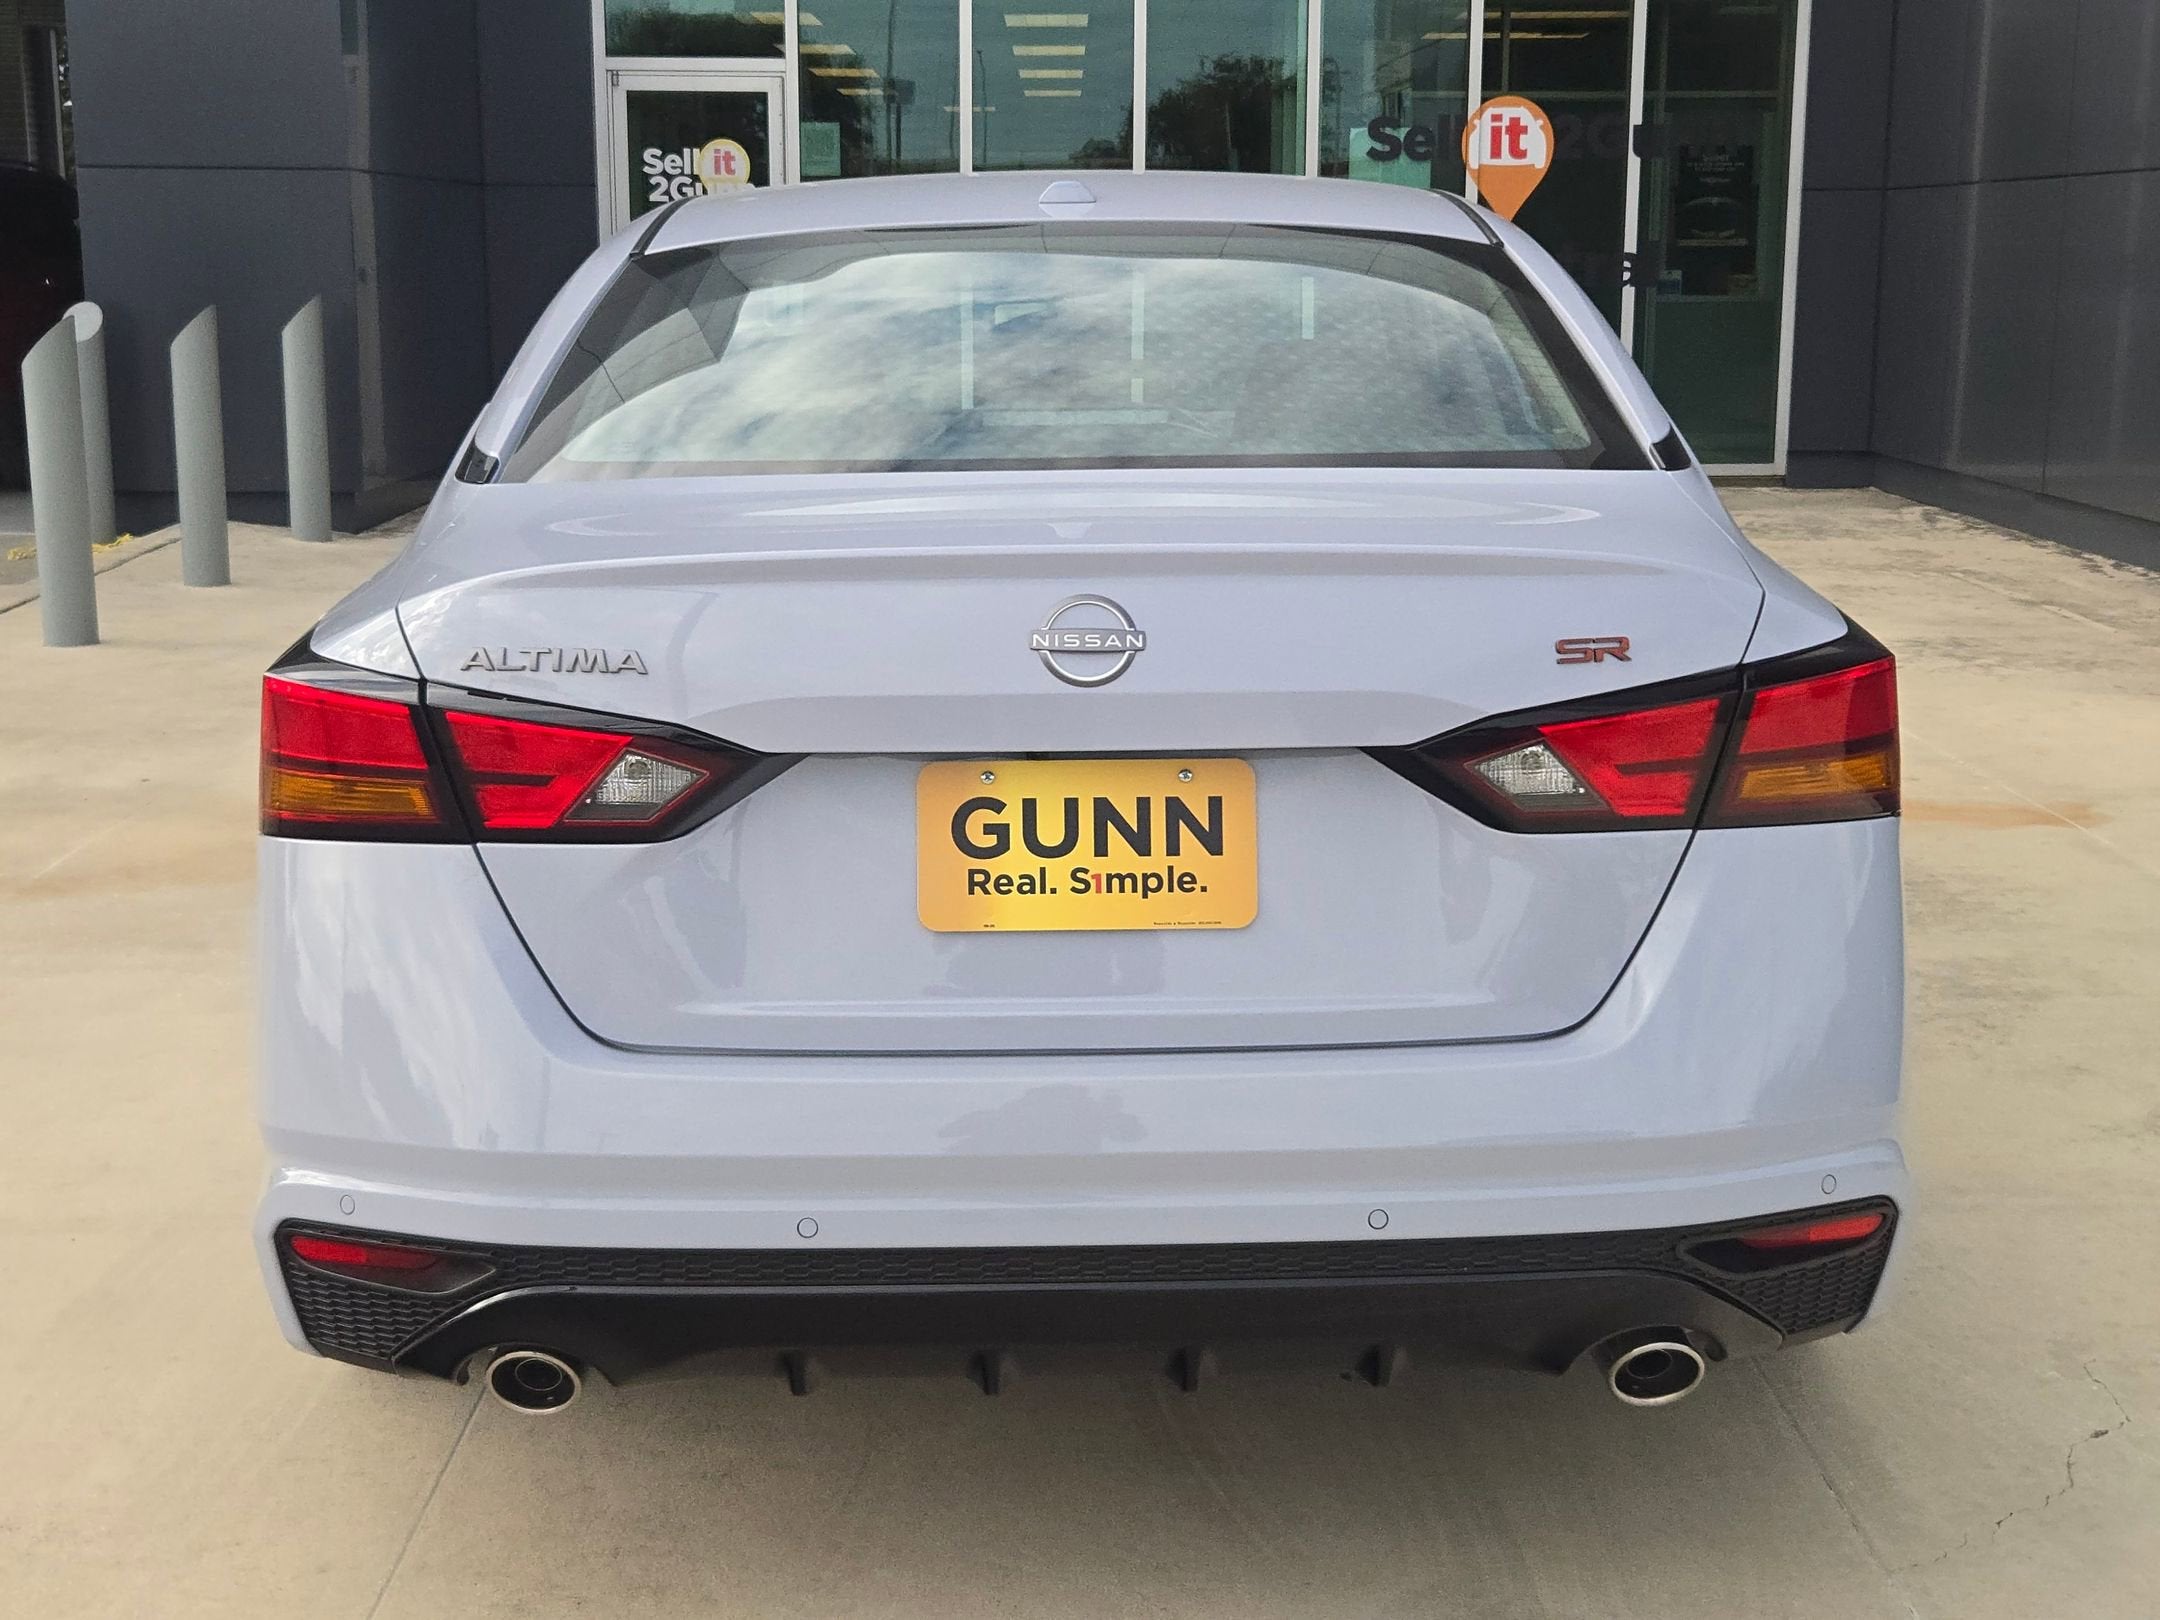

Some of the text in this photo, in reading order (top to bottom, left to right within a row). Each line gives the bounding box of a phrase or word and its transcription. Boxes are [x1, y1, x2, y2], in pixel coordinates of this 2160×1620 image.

[1490, 114, 1528, 159] it
[643, 148, 735, 175] Sell it
[1032, 634, 1143, 648] NISSAN
[1555, 637, 1632, 664] SR
[460, 647, 648, 675] ALTIMA
[951, 796, 1224, 859] GUNN
[967, 867, 1057, 895] Real.
